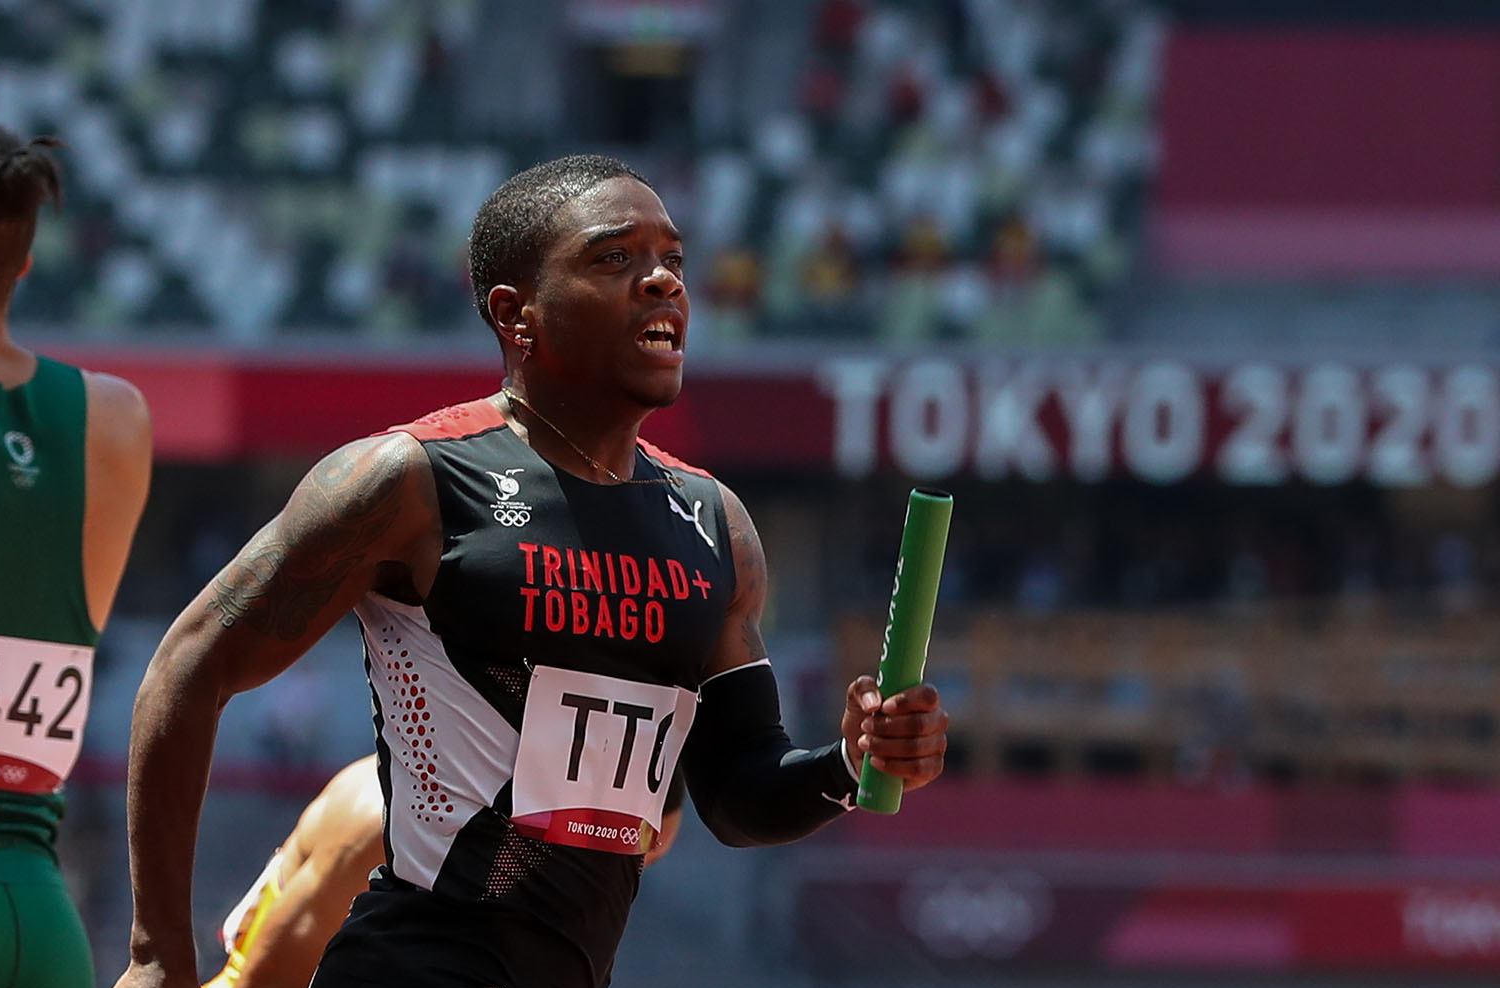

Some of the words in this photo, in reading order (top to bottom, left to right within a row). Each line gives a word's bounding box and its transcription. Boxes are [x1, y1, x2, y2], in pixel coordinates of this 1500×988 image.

[816, 355, 1200, 482] TOKYO
[1217, 361, 1500, 488] 2020
[518, 542, 712, 600] TRINIDAD+
[520, 586, 665, 643] TOBAGO
[567, 821, 595, 836] TOKYO
[595, 826, 618, 840] 2020
